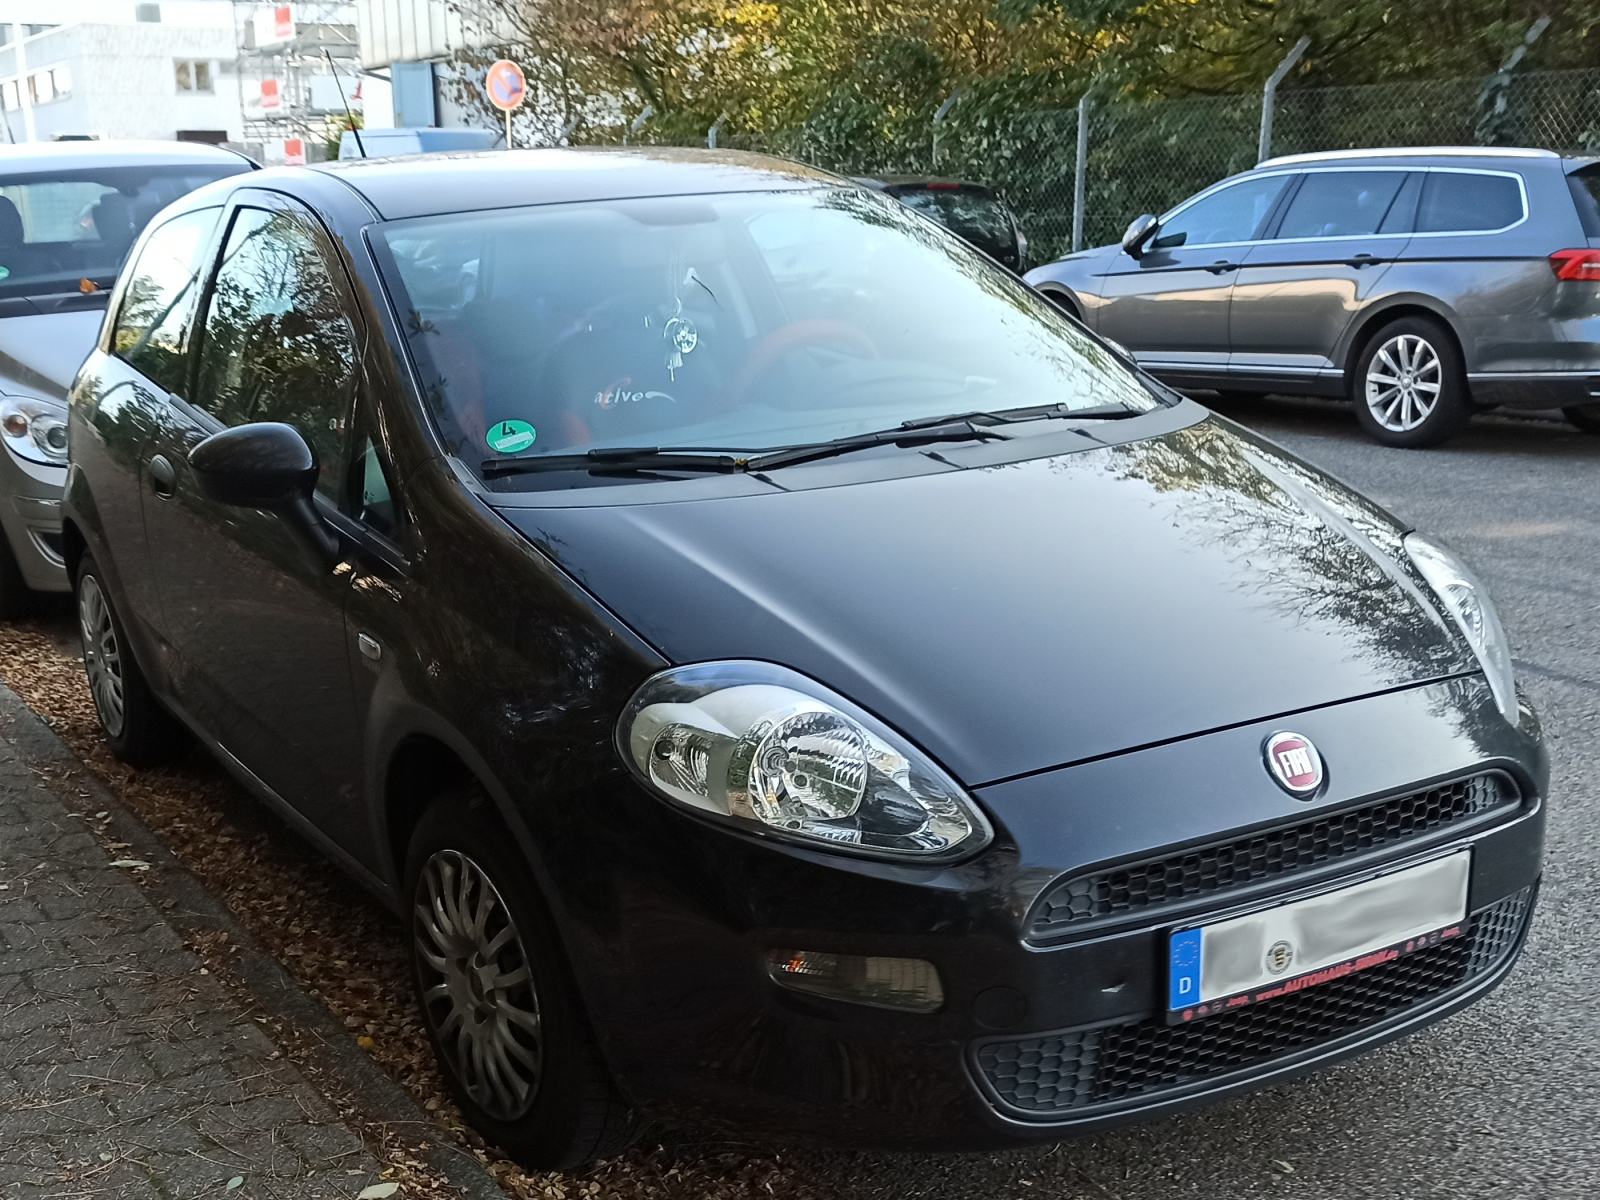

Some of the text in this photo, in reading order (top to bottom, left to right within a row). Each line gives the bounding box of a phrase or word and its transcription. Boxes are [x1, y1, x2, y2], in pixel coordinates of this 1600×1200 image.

[502, 421, 516, 436] 4
[1277, 746, 1313, 779] FIAT
[1179, 977, 1192, 994] D
